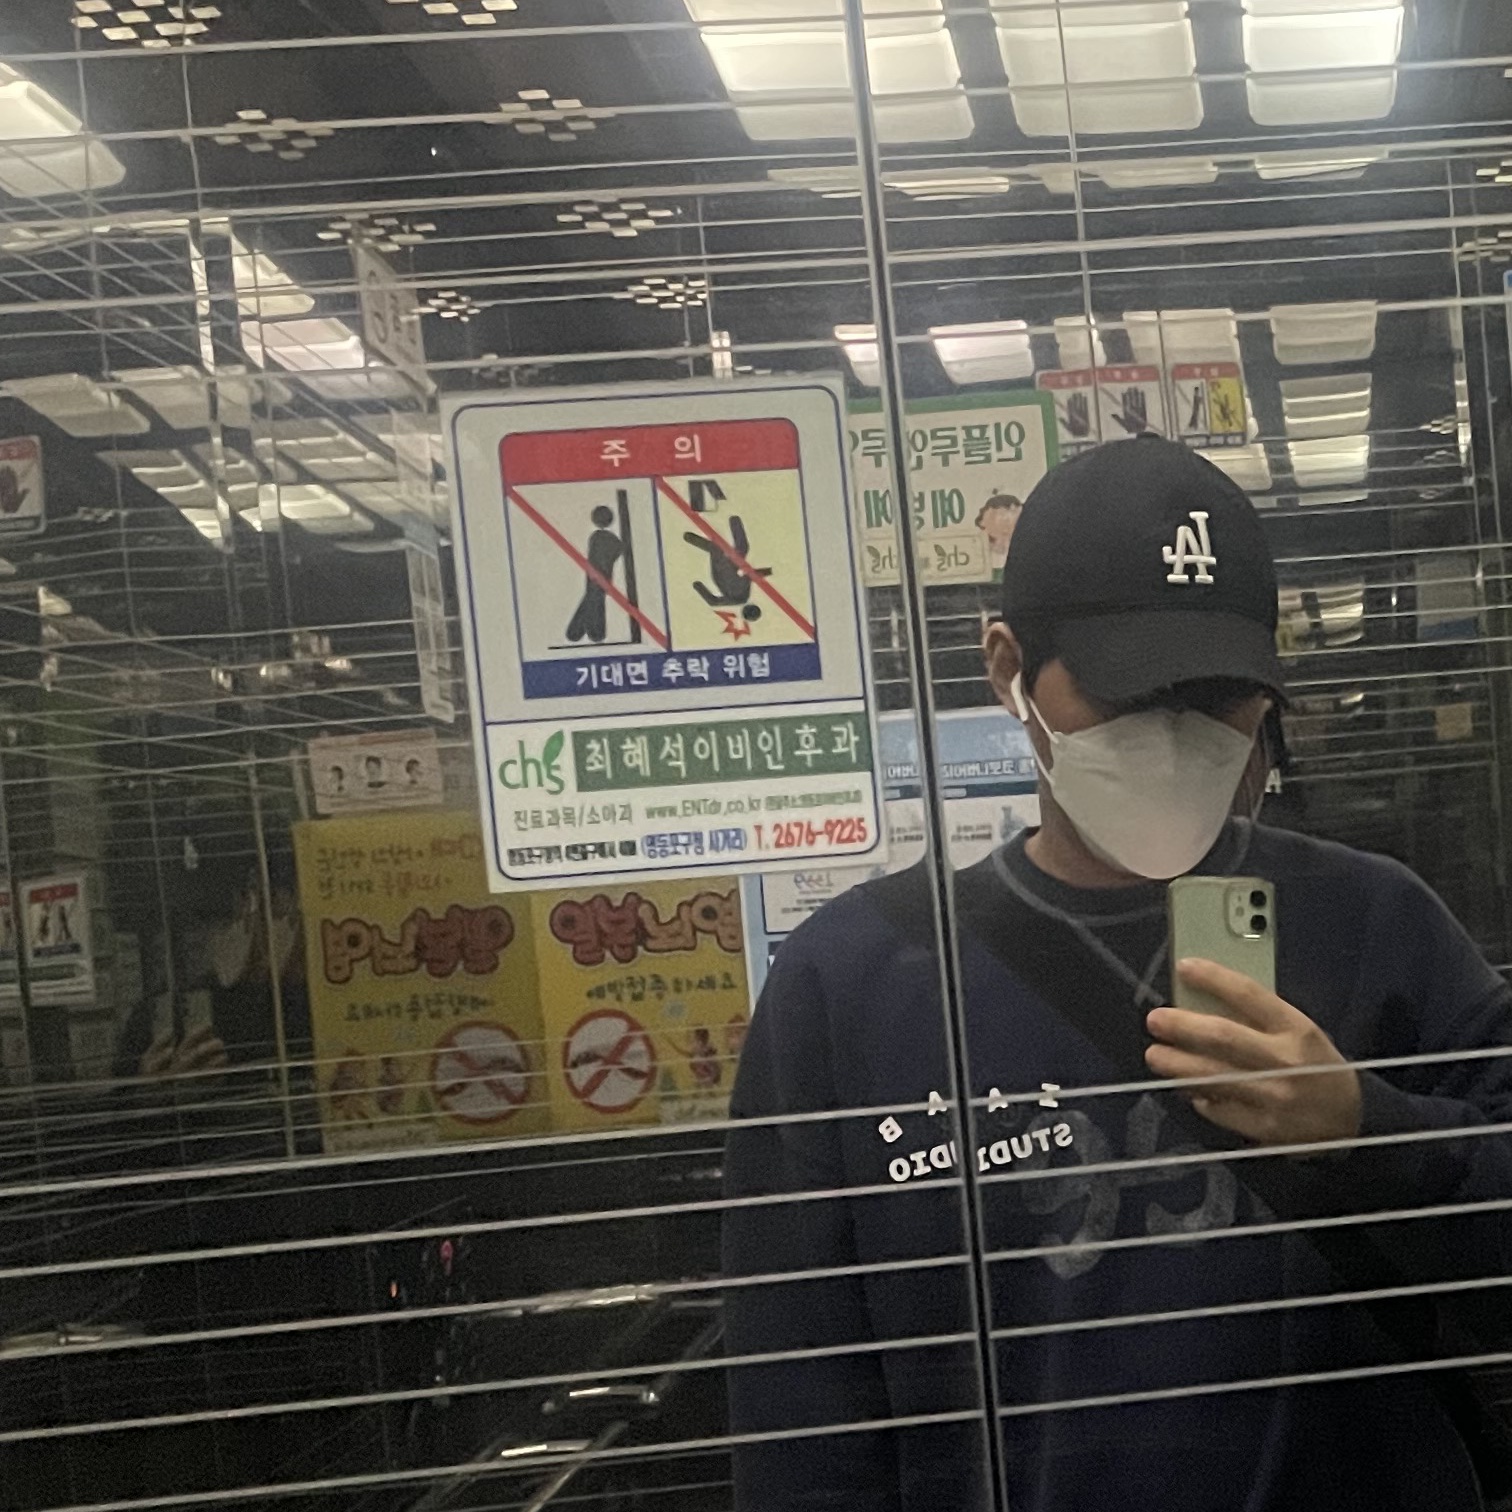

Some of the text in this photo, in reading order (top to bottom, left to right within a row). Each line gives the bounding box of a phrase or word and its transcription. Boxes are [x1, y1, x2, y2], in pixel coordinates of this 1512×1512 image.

[575, 651, 771, 690] 기대면 추락 위험
[498, 739, 566, 795] chs
[584, 720, 861, 781] 최혜석이비인후과
[773, 817, 868, 849] 2676-9225
